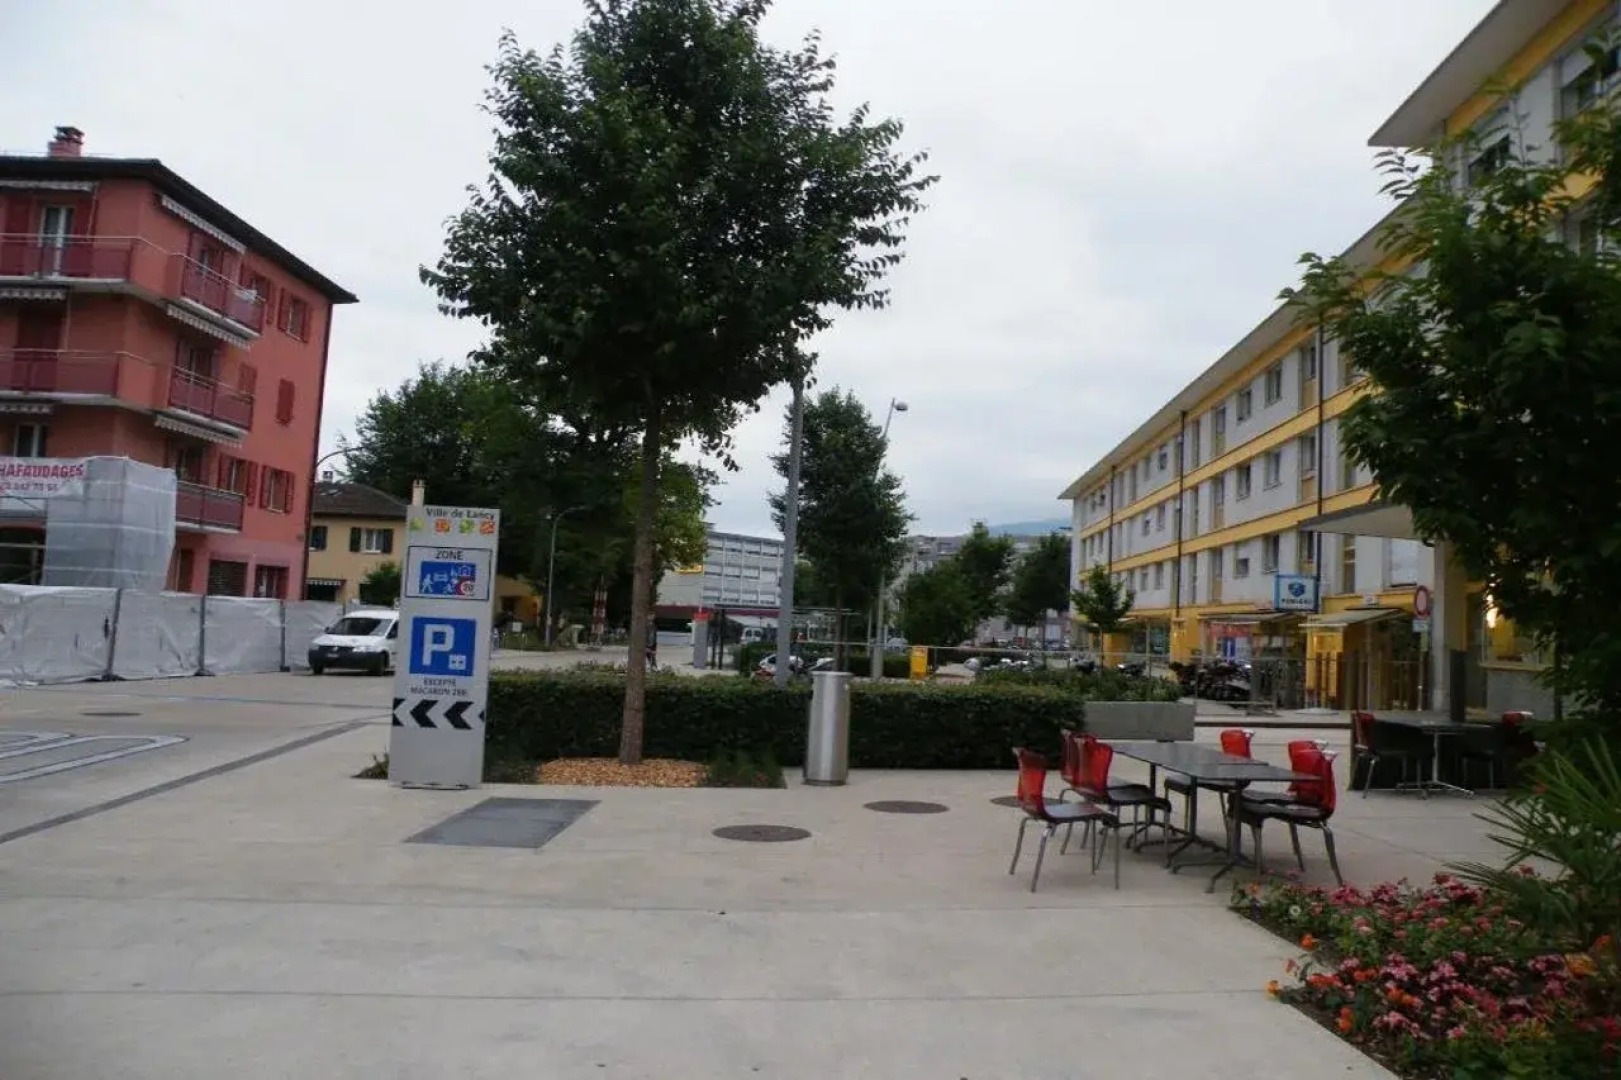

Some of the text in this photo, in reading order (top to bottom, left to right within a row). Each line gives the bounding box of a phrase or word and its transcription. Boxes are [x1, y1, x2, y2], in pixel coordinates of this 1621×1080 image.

[425, 507, 494, 520] Ville de Lancy
[435, 549, 463, 560] ZONE
[422, 624, 455, 667] P
